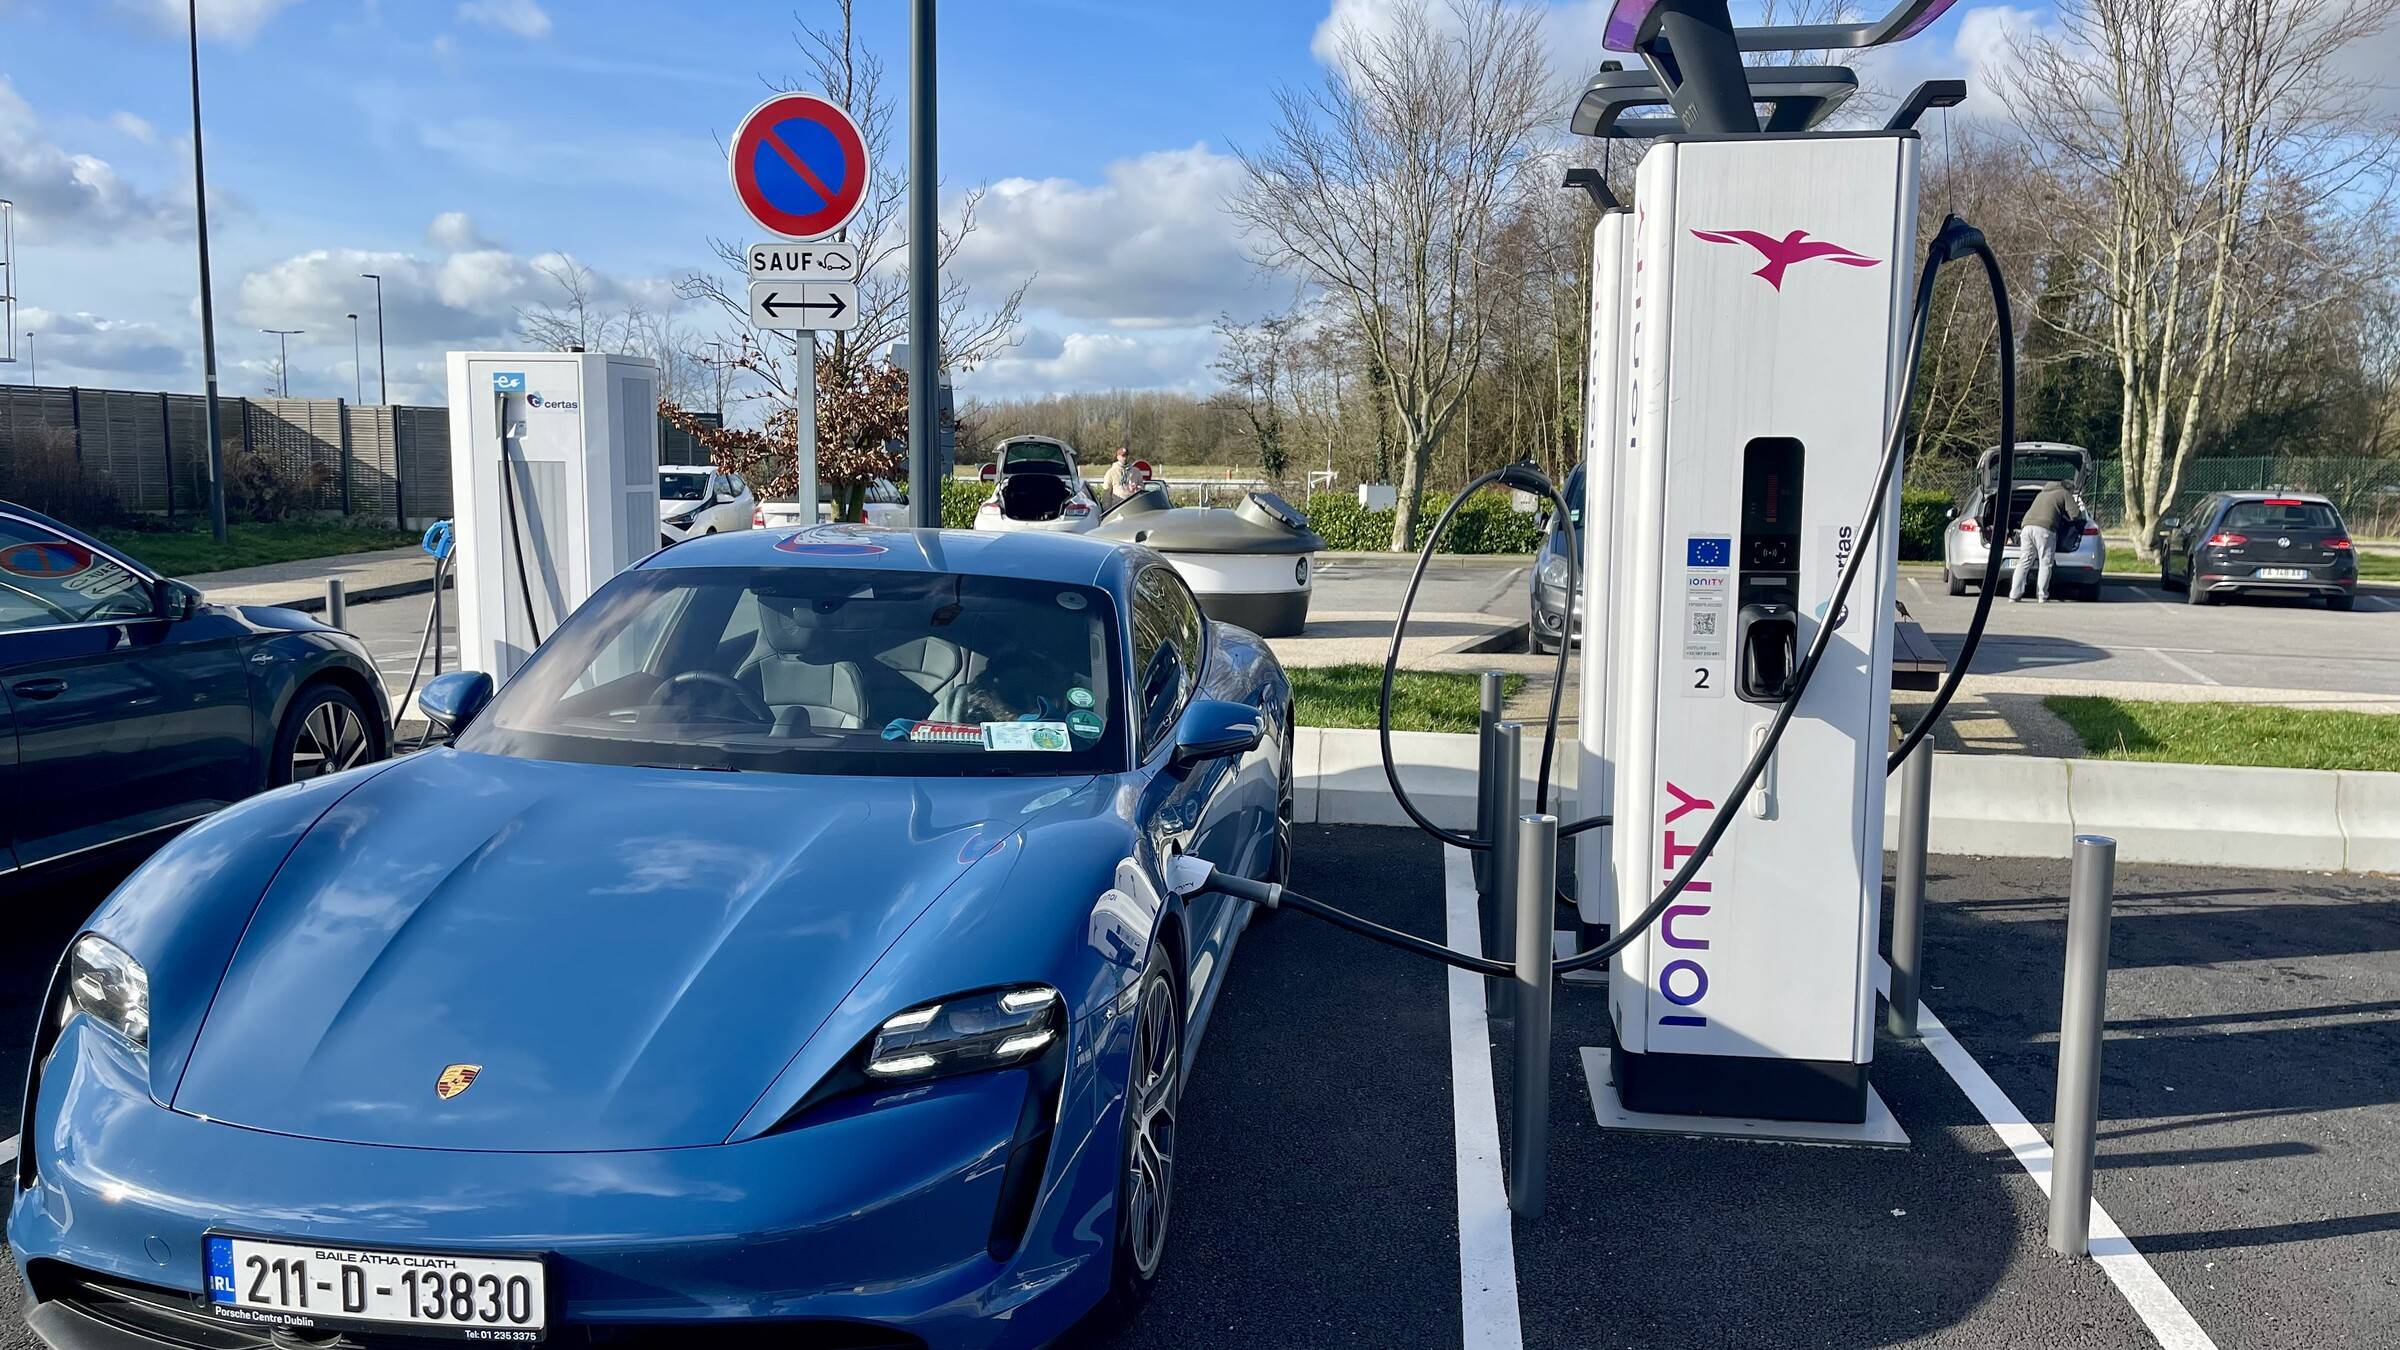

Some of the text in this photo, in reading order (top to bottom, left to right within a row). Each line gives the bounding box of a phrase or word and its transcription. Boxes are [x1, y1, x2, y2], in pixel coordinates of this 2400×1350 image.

[753, 251, 813, 271] SAUF
[544, 400, 578, 409] certas
[1835, 525, 1852, 579] rtas
[1689, 578, 1725, 586] IONITY
[1694, 667, 1710, 689] 2
[1658, 780, 1716, 1027] IONITY
[315, 1251, 456, 1269] BAILE ÁTHA CLIATH
[210, 1276, 235, 1292] IRL
[215, 1306, 314, 1327] Porsche Centre Dublin
[464, 1330, 537, 1341] Tel: 01 235 3375
